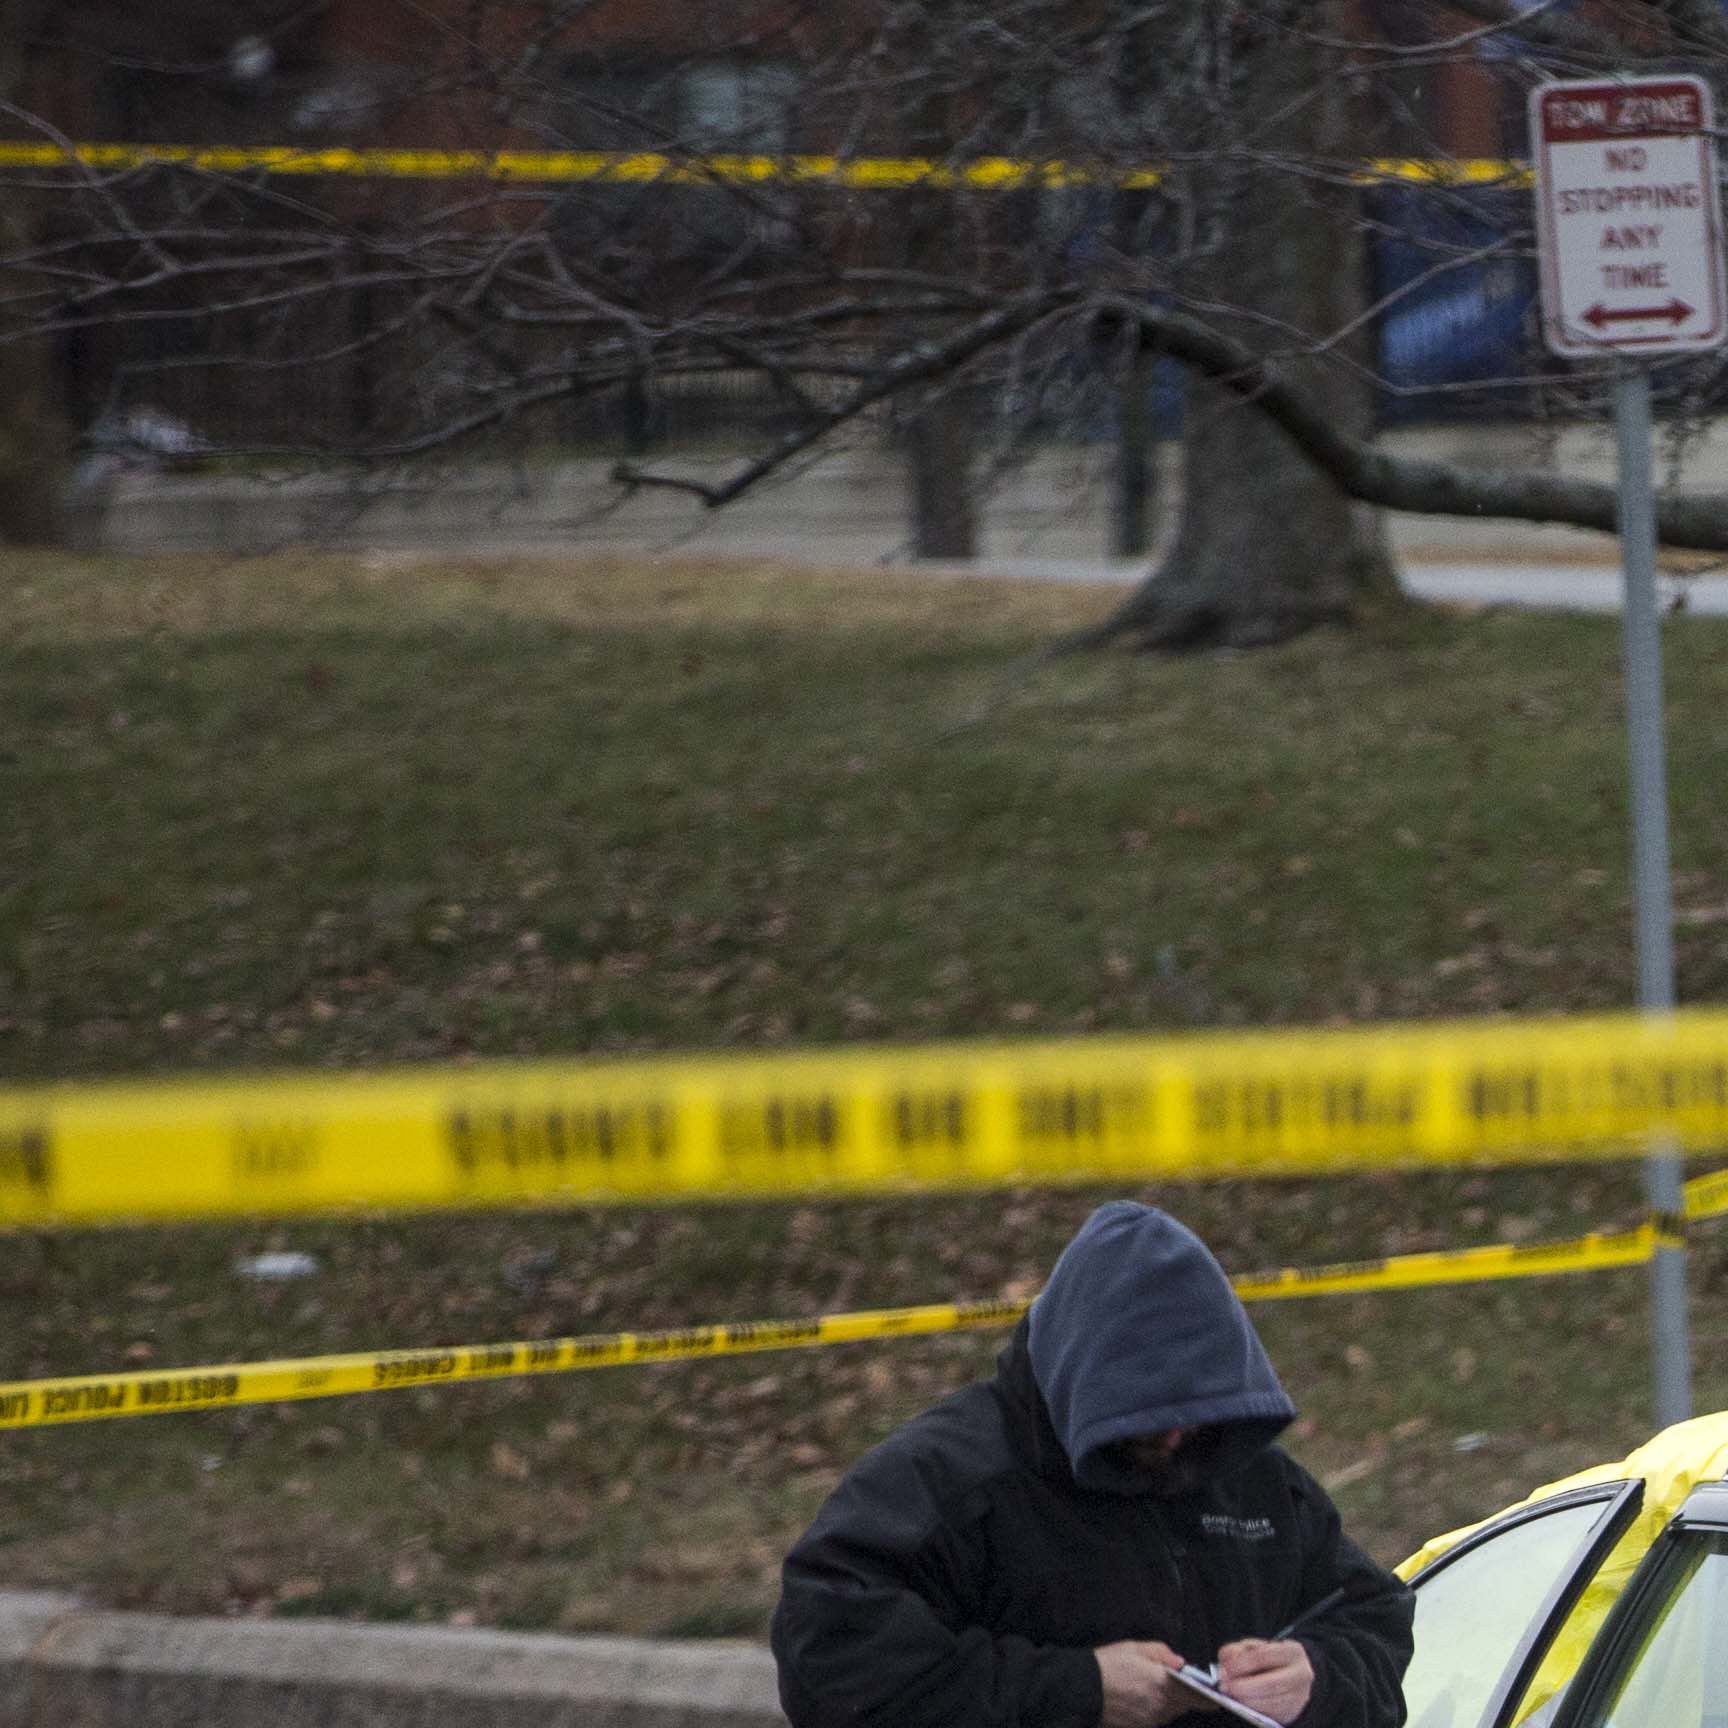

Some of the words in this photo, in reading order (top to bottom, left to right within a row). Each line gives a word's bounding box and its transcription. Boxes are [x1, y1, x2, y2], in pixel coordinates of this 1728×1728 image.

[1605, 147, 1648, 171] NO
[1557, 183, 1700, 214] STOPPING
[1600, 224, 1662, 250] ANY
[1600, 263, 1669, 288] TIME
